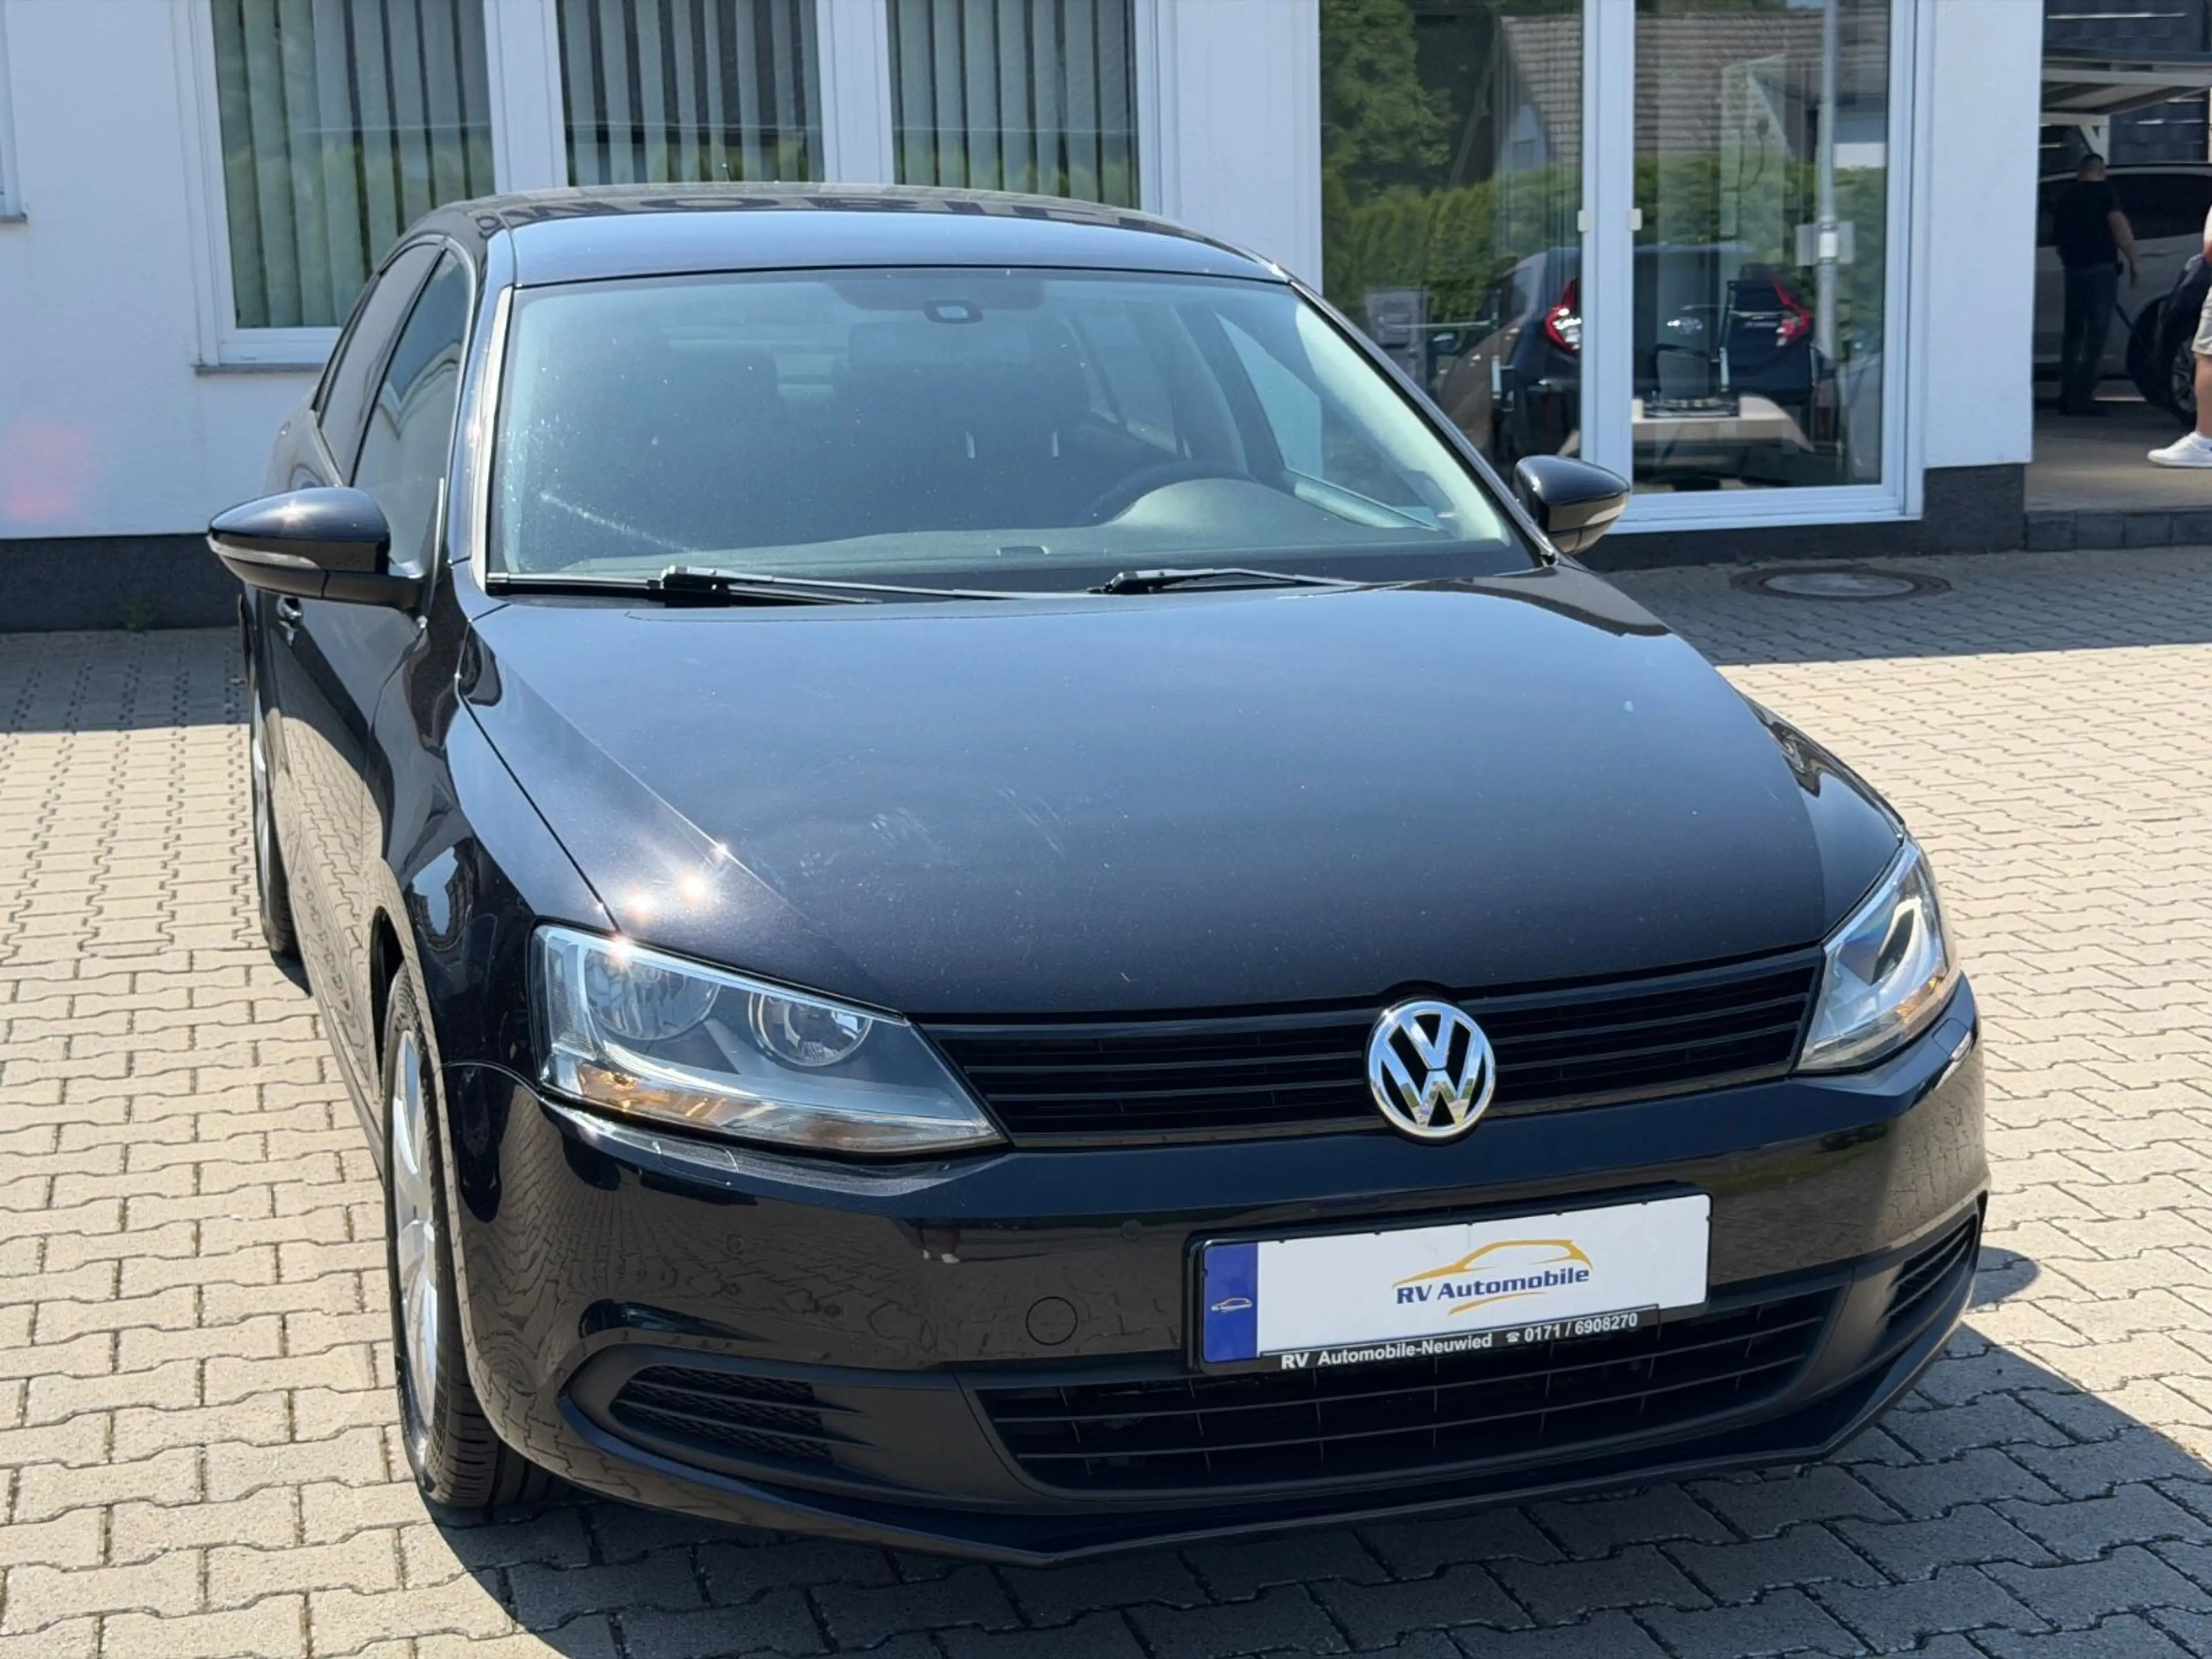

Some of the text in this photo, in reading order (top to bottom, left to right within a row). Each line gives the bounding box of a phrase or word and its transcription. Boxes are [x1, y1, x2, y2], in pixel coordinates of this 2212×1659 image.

[1369, 1001, 1495, 1137] VW
[1396, 1267, 1590, 1304] RV Automobile
[1281, 1312, 1638, 1370] RV Automobile-Neuwied 0171 / 6908270
